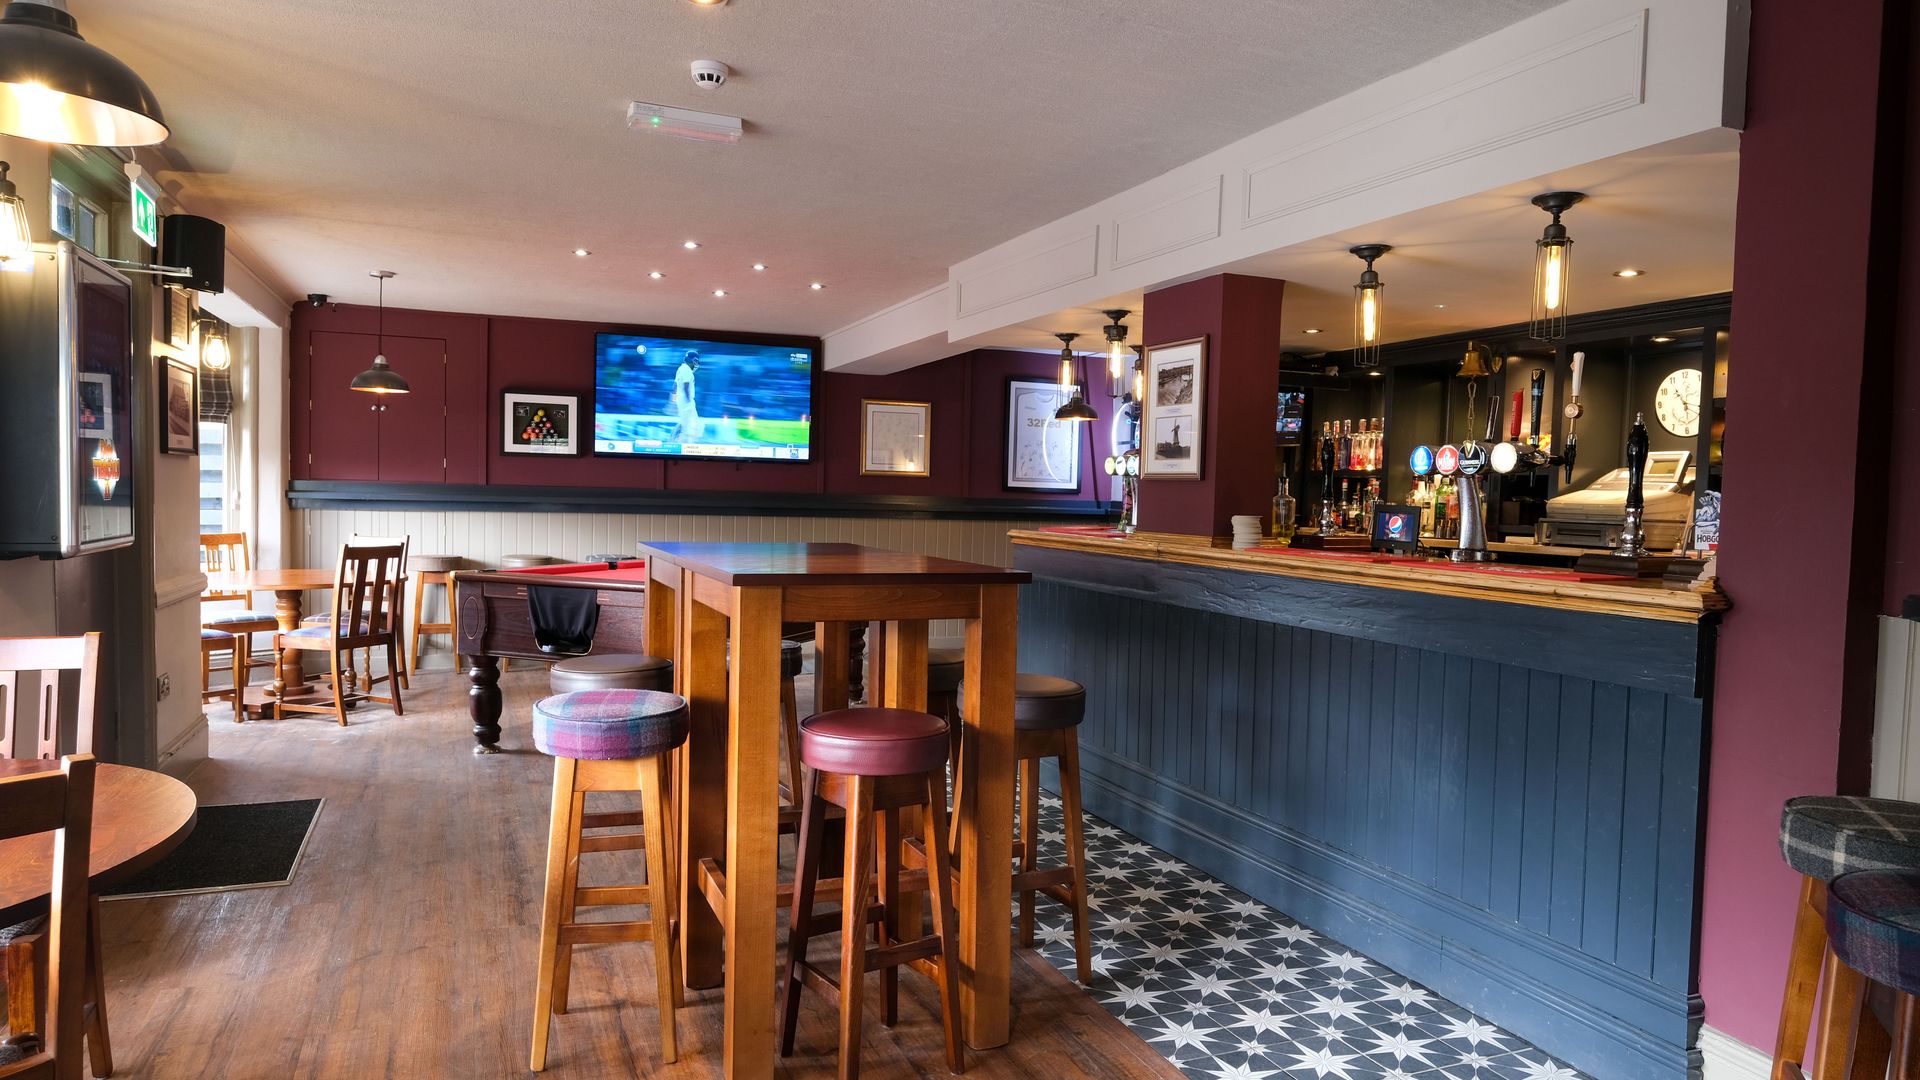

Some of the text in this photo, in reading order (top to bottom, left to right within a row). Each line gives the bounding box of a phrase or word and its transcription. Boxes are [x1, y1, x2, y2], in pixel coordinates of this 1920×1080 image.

[1682, 371, 1689, 379] 12
[1660, 388, 1668, 396] 10
[1657, 401, 1662, 409] 9
[1661, 413, 1666, 421] 8
[1027, 417, 1061, 429] 32Red
[1672, 423, 1676, 431] 7
[1684, 427, 1690, 435] 6
